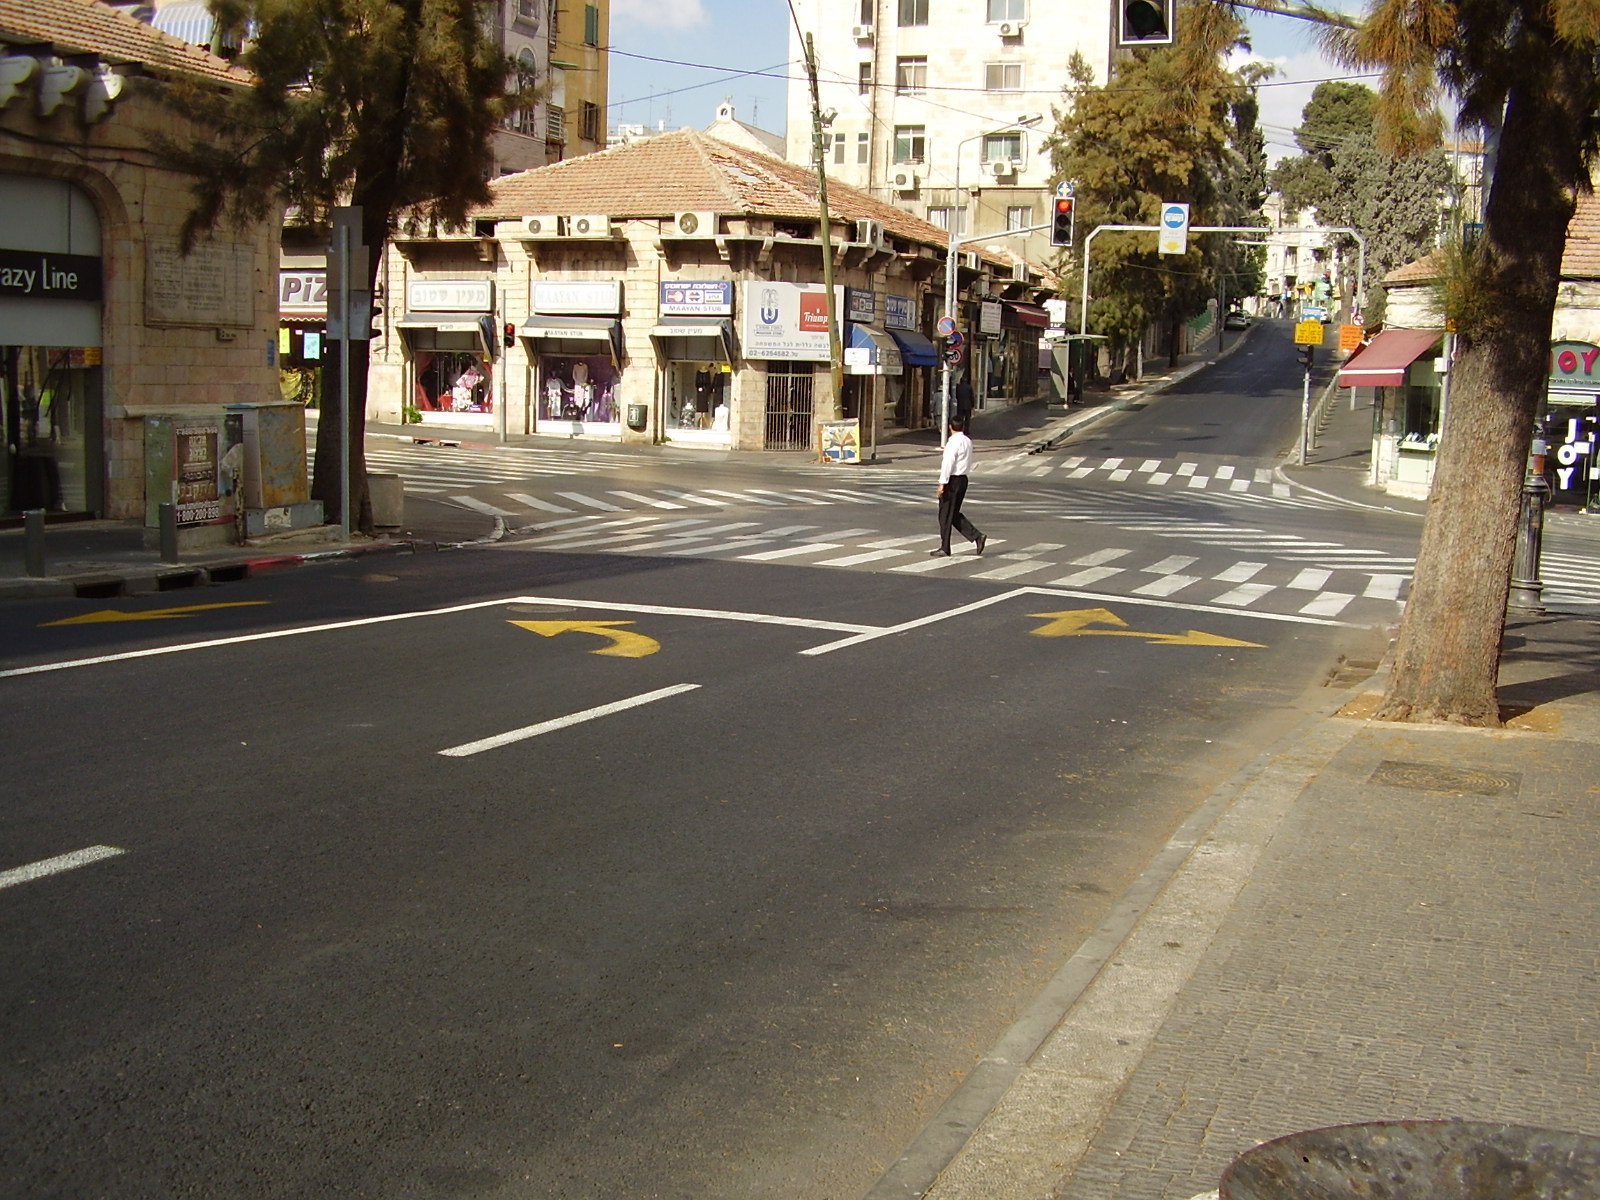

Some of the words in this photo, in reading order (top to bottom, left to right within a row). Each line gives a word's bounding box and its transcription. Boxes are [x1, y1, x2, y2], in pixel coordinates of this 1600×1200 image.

[0, 267, 36, 293] azy
[42, 258, 78, 290] Line
[282, 277, 327, 302] PiZ
[537, 290, 578, 304] MAAYAN
[585, 290, 615, 304] STUB
[804, 311, 829, 324] Triump
[1548, 348, 1600, 376] OY
[1556, 418, 1578, 490] JOY
